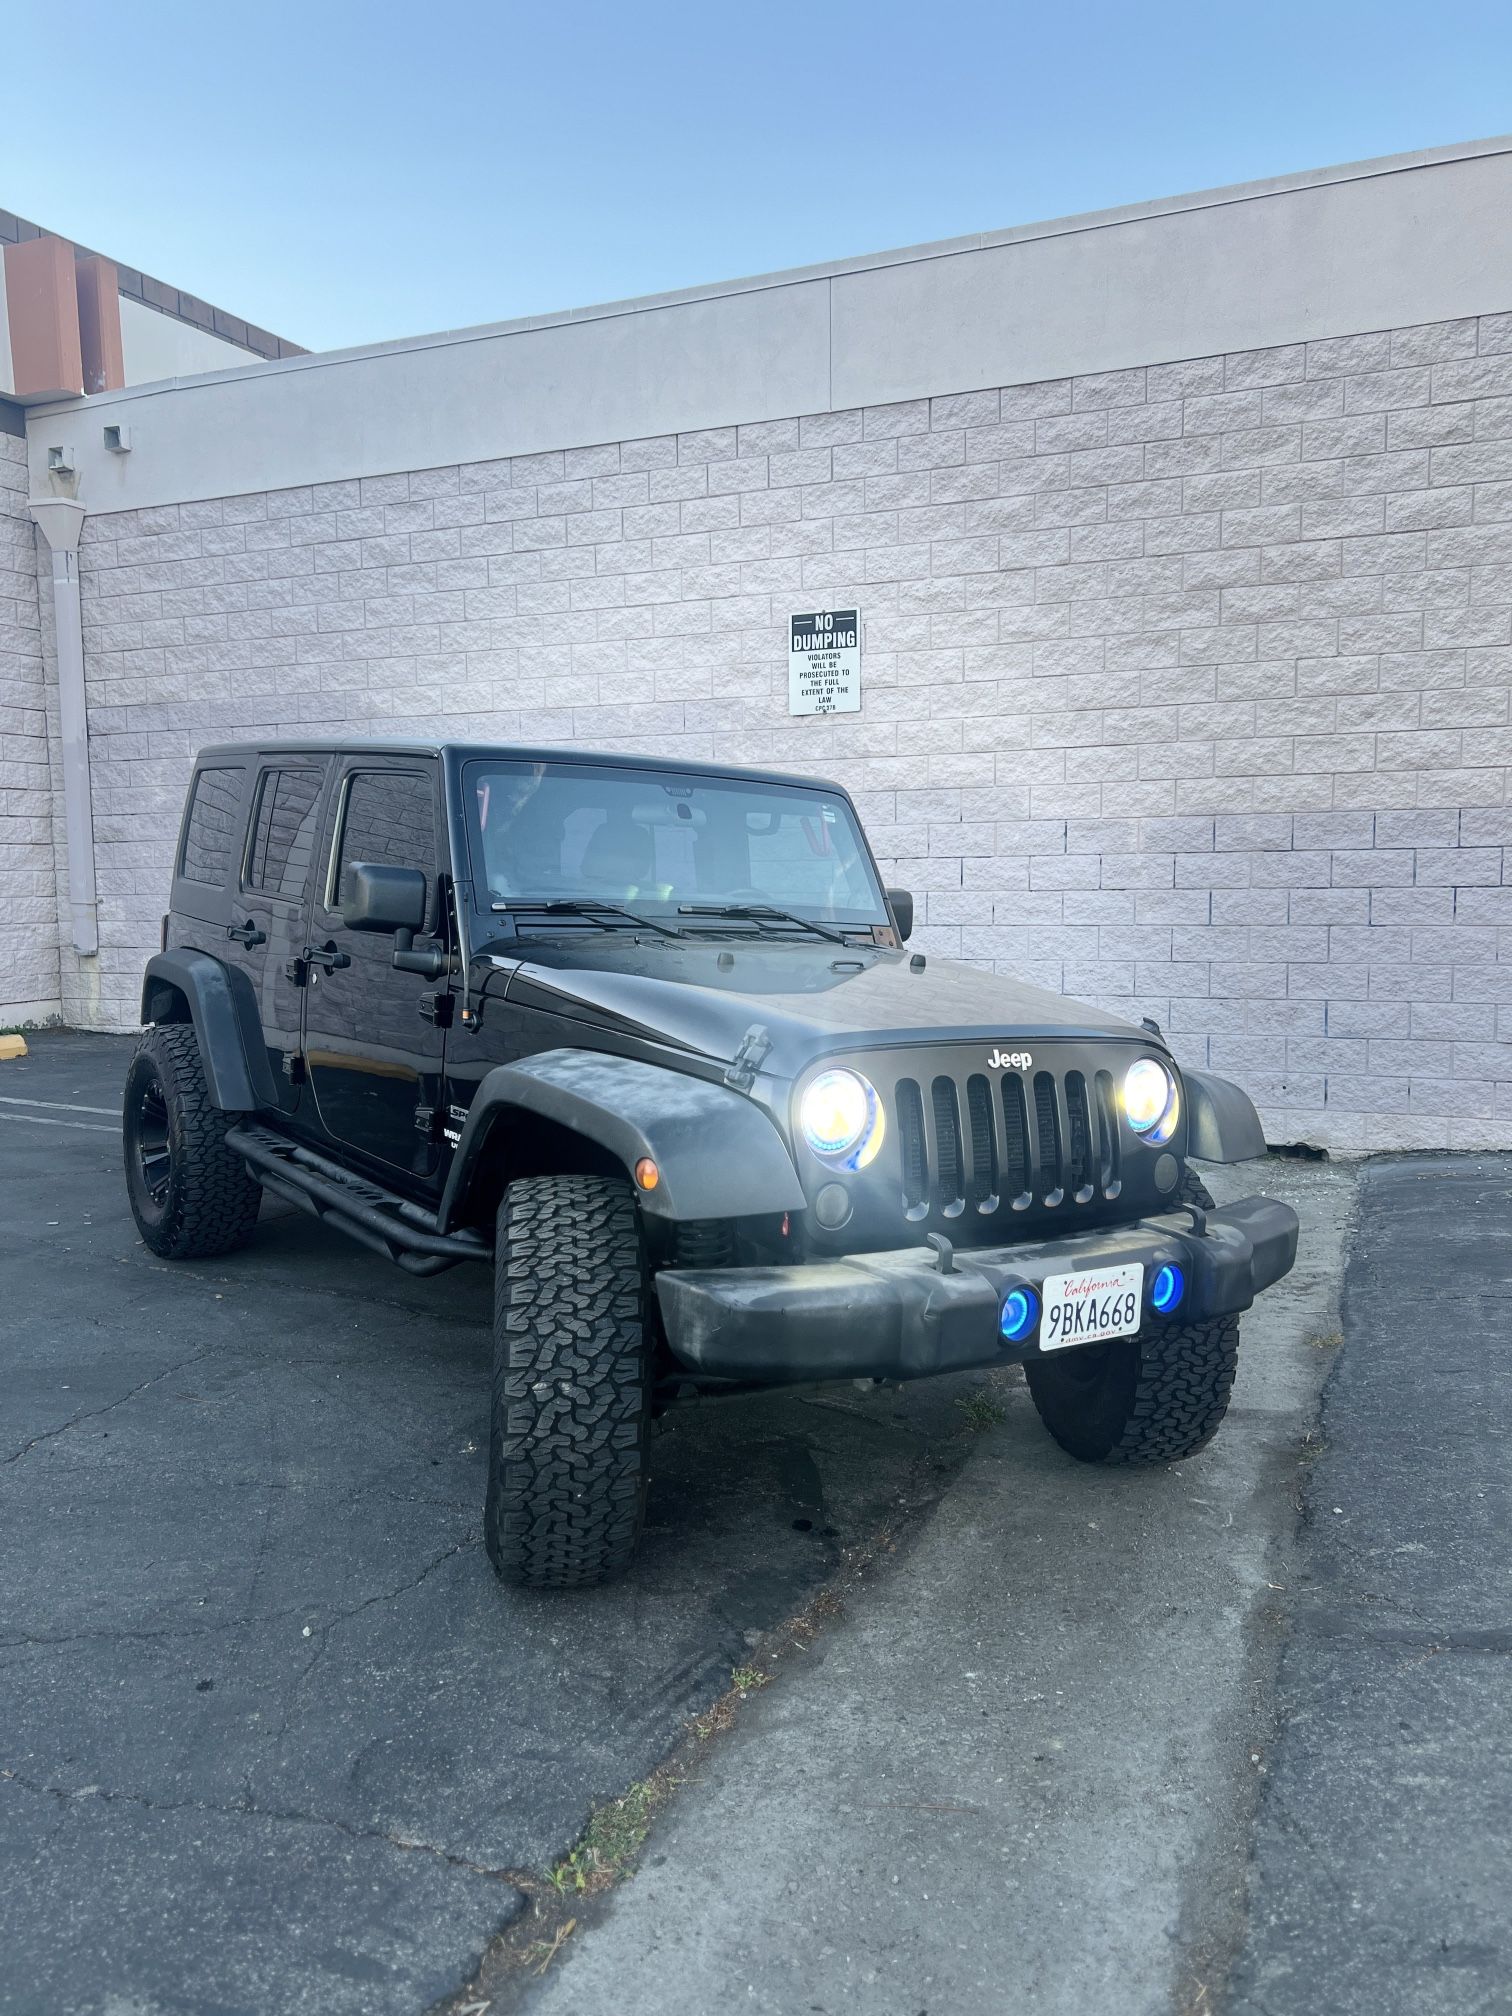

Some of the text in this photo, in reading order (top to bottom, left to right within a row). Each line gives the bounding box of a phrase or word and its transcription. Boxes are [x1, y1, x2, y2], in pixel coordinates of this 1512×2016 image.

[815, 614, 834, 631] NO
[793, 630, 856, 651] DUMPING
[807, 652, 841, 661] VIOLATORS
[811, 661, 826, 670] WILL
[799, 668, 850, 679] PROSECUTED TO
[810, 678, 839, 687] THE FULL
[801, 687, 823, 696] EXTENT
[818, 696, 832, 704] LAW
[988, 1049, 1032, 1071] Jeep
[1064, 1277, 1124, 1298] California
[1048, 1292, 1136, 1339] 9BKA668
[1065, 1330, 1116, 1344] dmv.ca.gov
